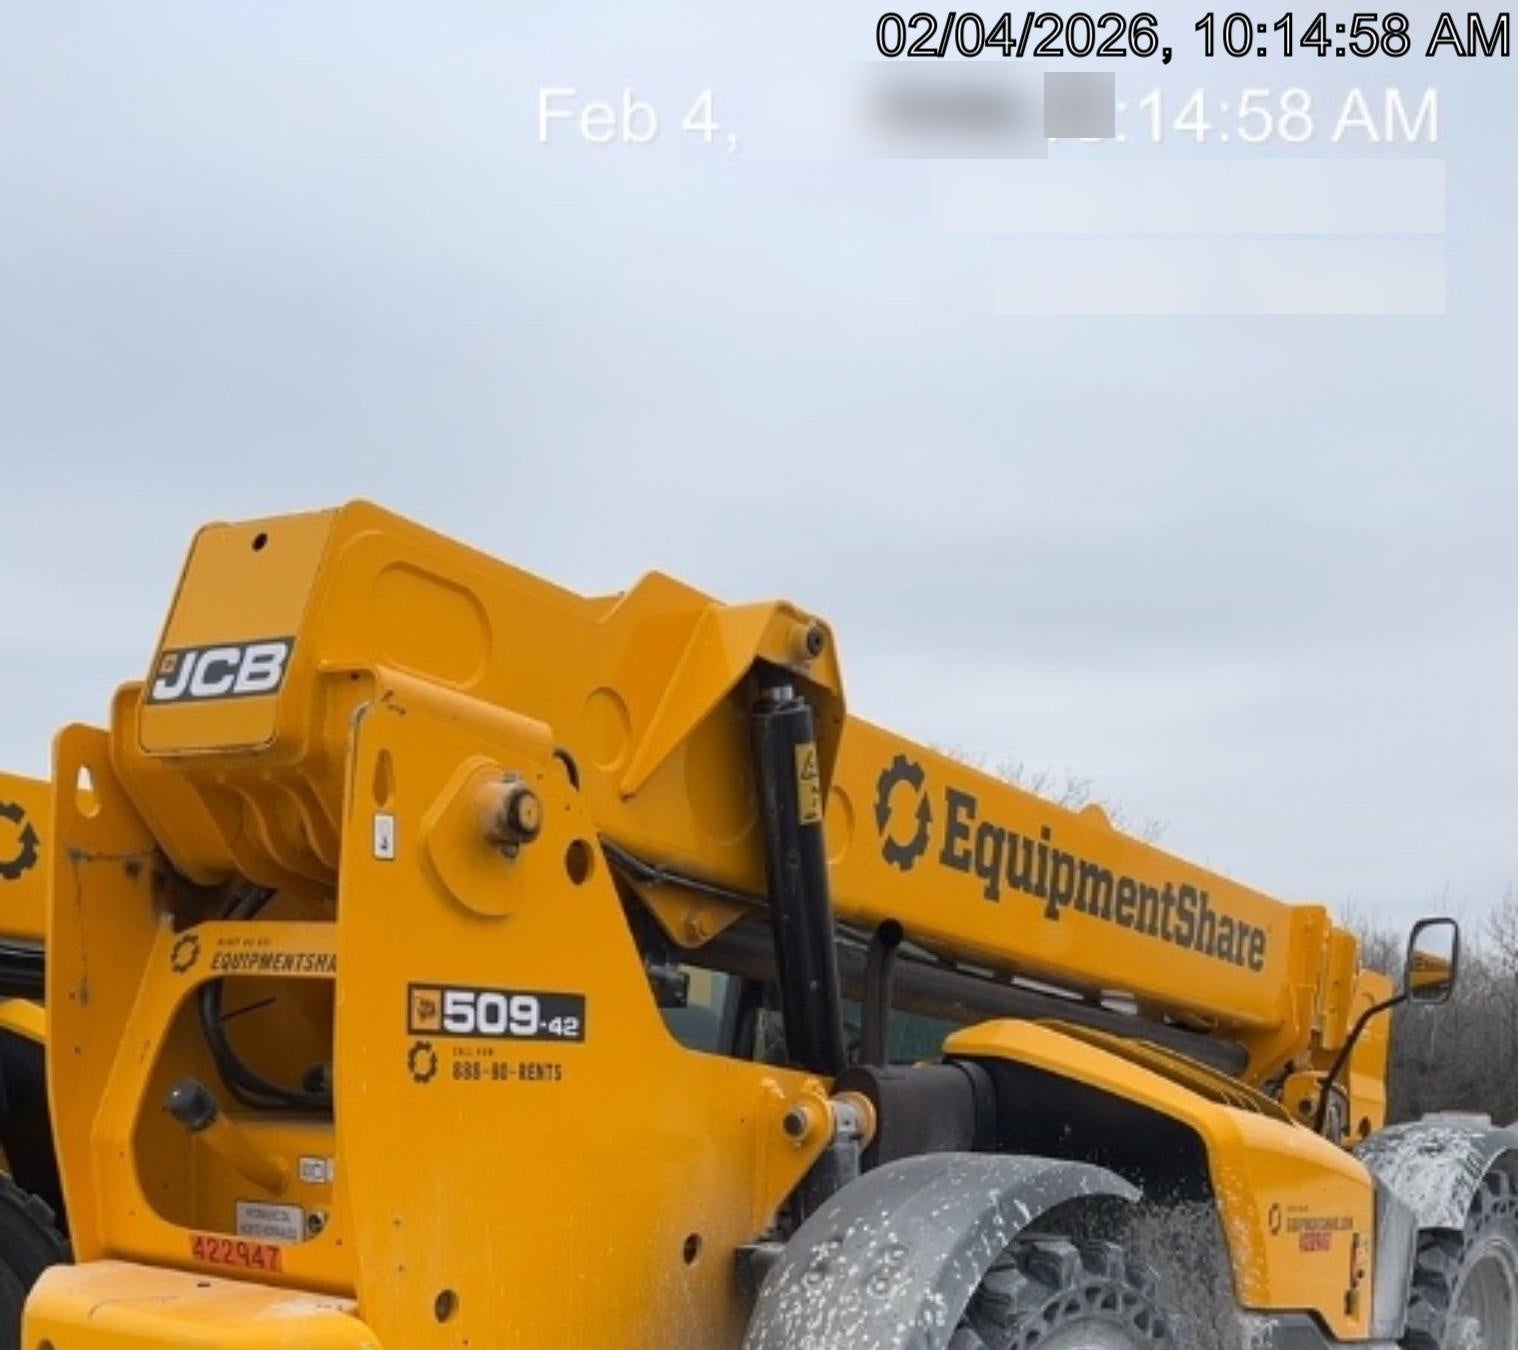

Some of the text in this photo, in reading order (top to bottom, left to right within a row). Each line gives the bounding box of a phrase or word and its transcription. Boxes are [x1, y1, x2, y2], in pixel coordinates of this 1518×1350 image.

[152, 642, 289, 700] JCB
[938, 786, 1267, 972] EquipmentShare
[443, 989, 580, 1037] 509-42
[192, 1236, 280, 1272] 422947
